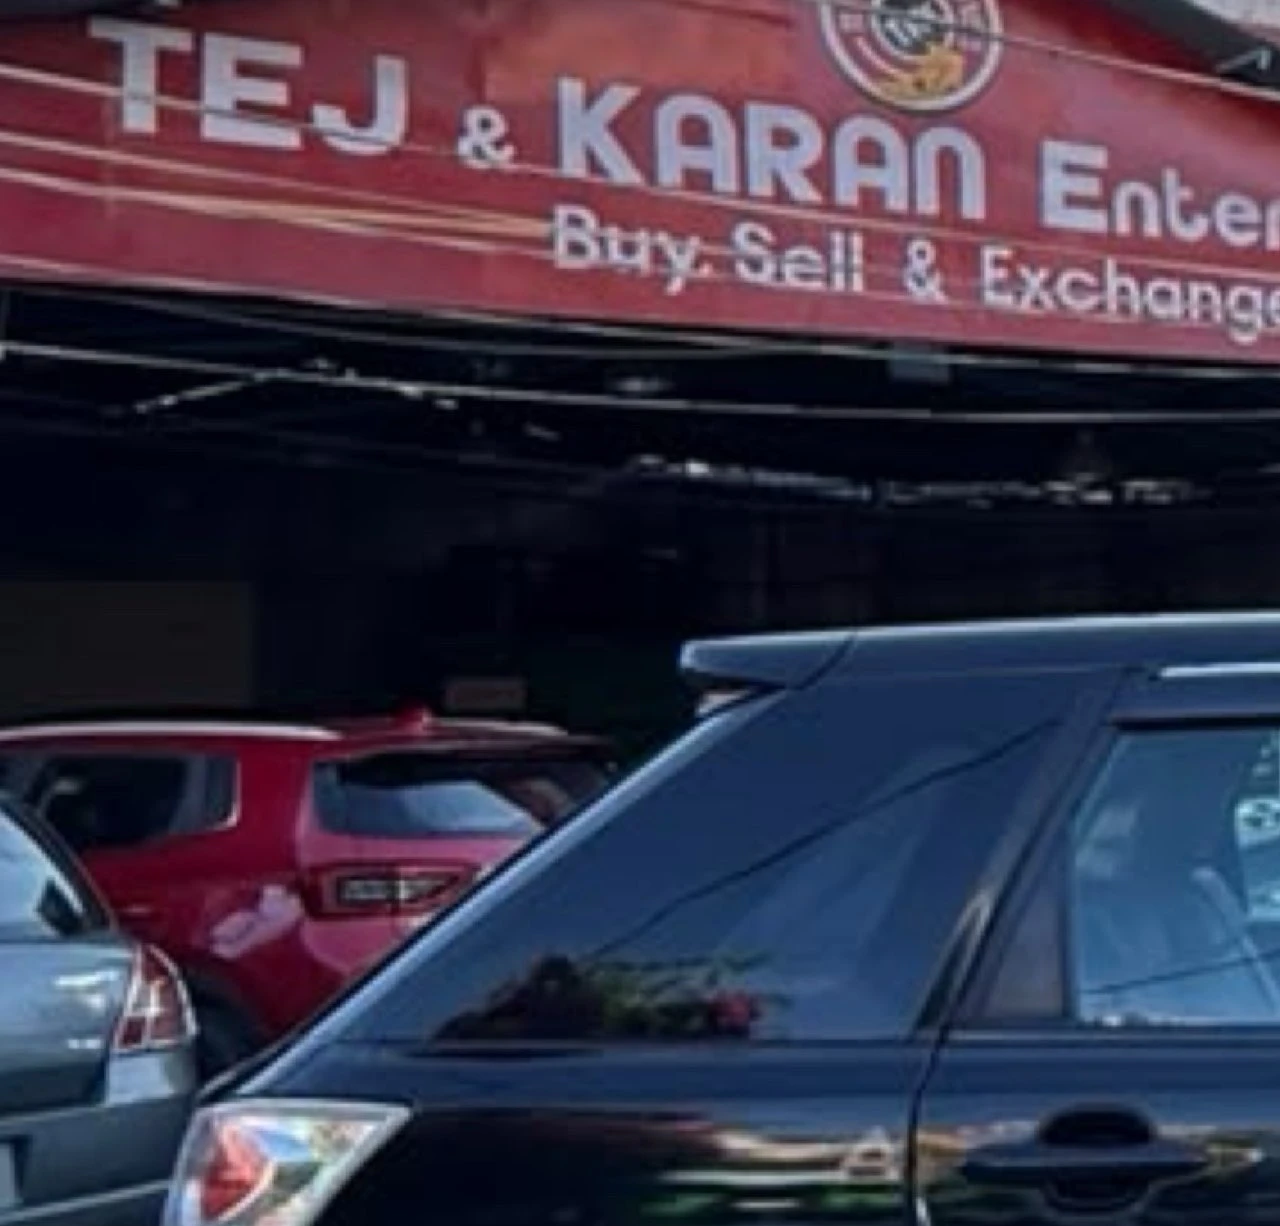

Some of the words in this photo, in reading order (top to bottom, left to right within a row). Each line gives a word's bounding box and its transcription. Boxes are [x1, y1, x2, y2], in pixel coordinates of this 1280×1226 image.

[88, 17, 407, 155] TEJ
[457, 105, 515, 168] &
[556, 76, 986, 220] KARAN
[732, 222, 866, 292] Sell
[904, 240, 946, 304] &
